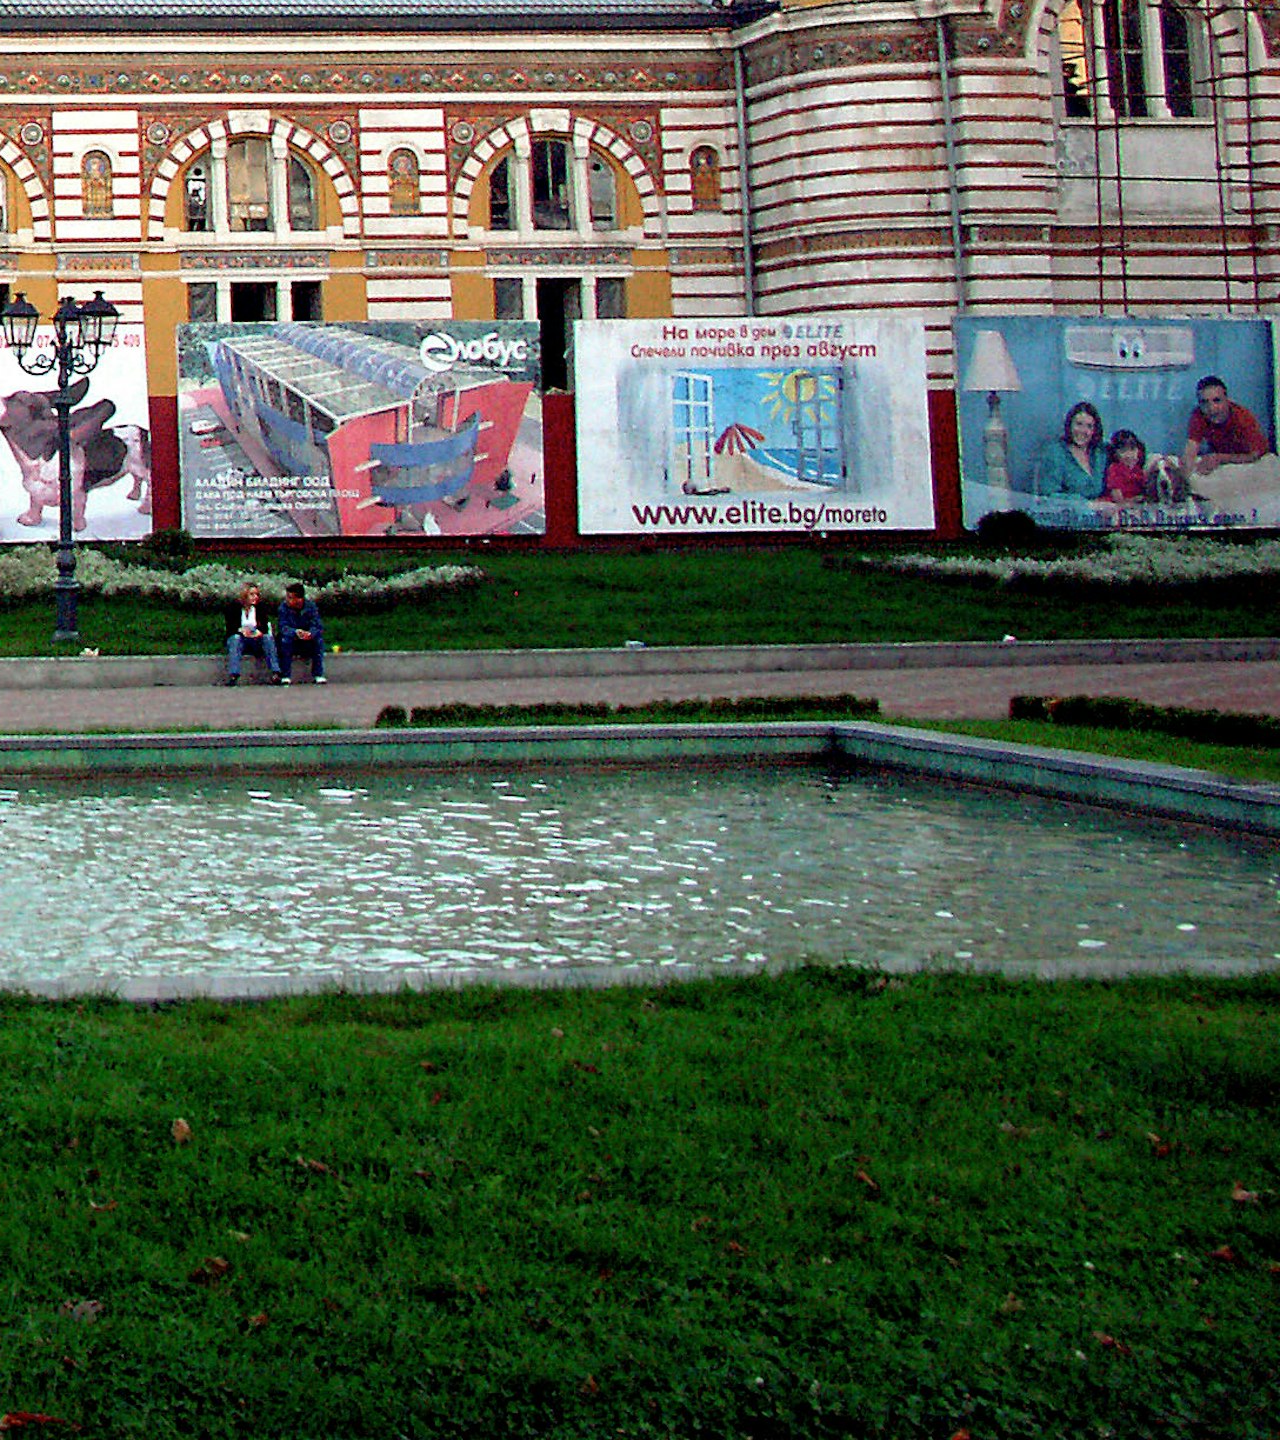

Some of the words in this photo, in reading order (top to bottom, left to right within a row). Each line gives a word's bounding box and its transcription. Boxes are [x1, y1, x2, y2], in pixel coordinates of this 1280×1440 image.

[663, 326, 688, 340] На
[695, 328, 735, 343] море
[740, 325, 748, 339] в
[752, 328, 776, 341] дом
[795, 325, 844, 339] ELITE
[631, 344, 686, 358] Спечели
[691, 343, 755, 358] почивка
[761, 345, 801, 361] през
[807, 342, 877, 361] август
[631, 500, 888, 529] www.elite.bg/moreto
